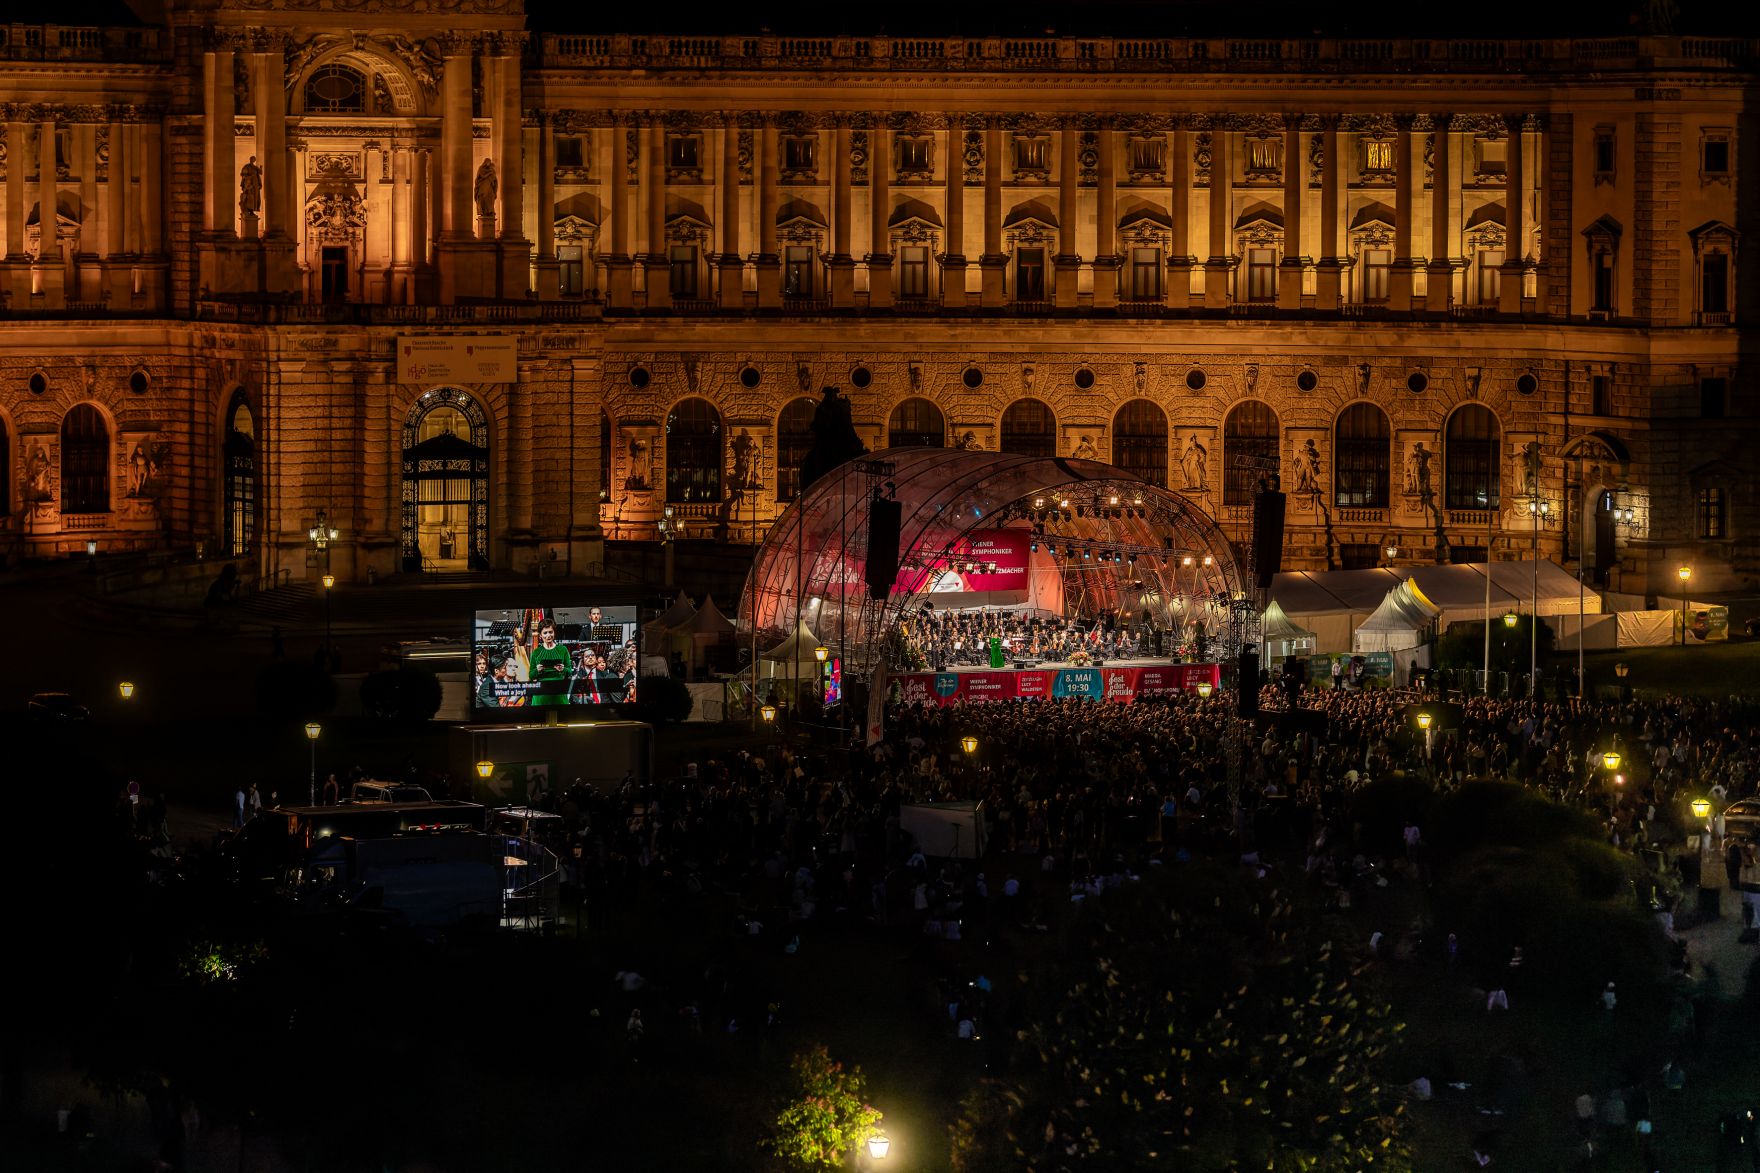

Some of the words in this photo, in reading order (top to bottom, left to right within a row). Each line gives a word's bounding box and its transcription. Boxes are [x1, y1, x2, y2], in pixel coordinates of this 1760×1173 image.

[1065, 674, 1073, 682] 8.
[1075, 674, 1092, 682] MAI
[1109, 672, 1124, 686] Fest
[1067, 683, 1089, 692] 19:30
[1107, 686, 1133, 698] Freude
